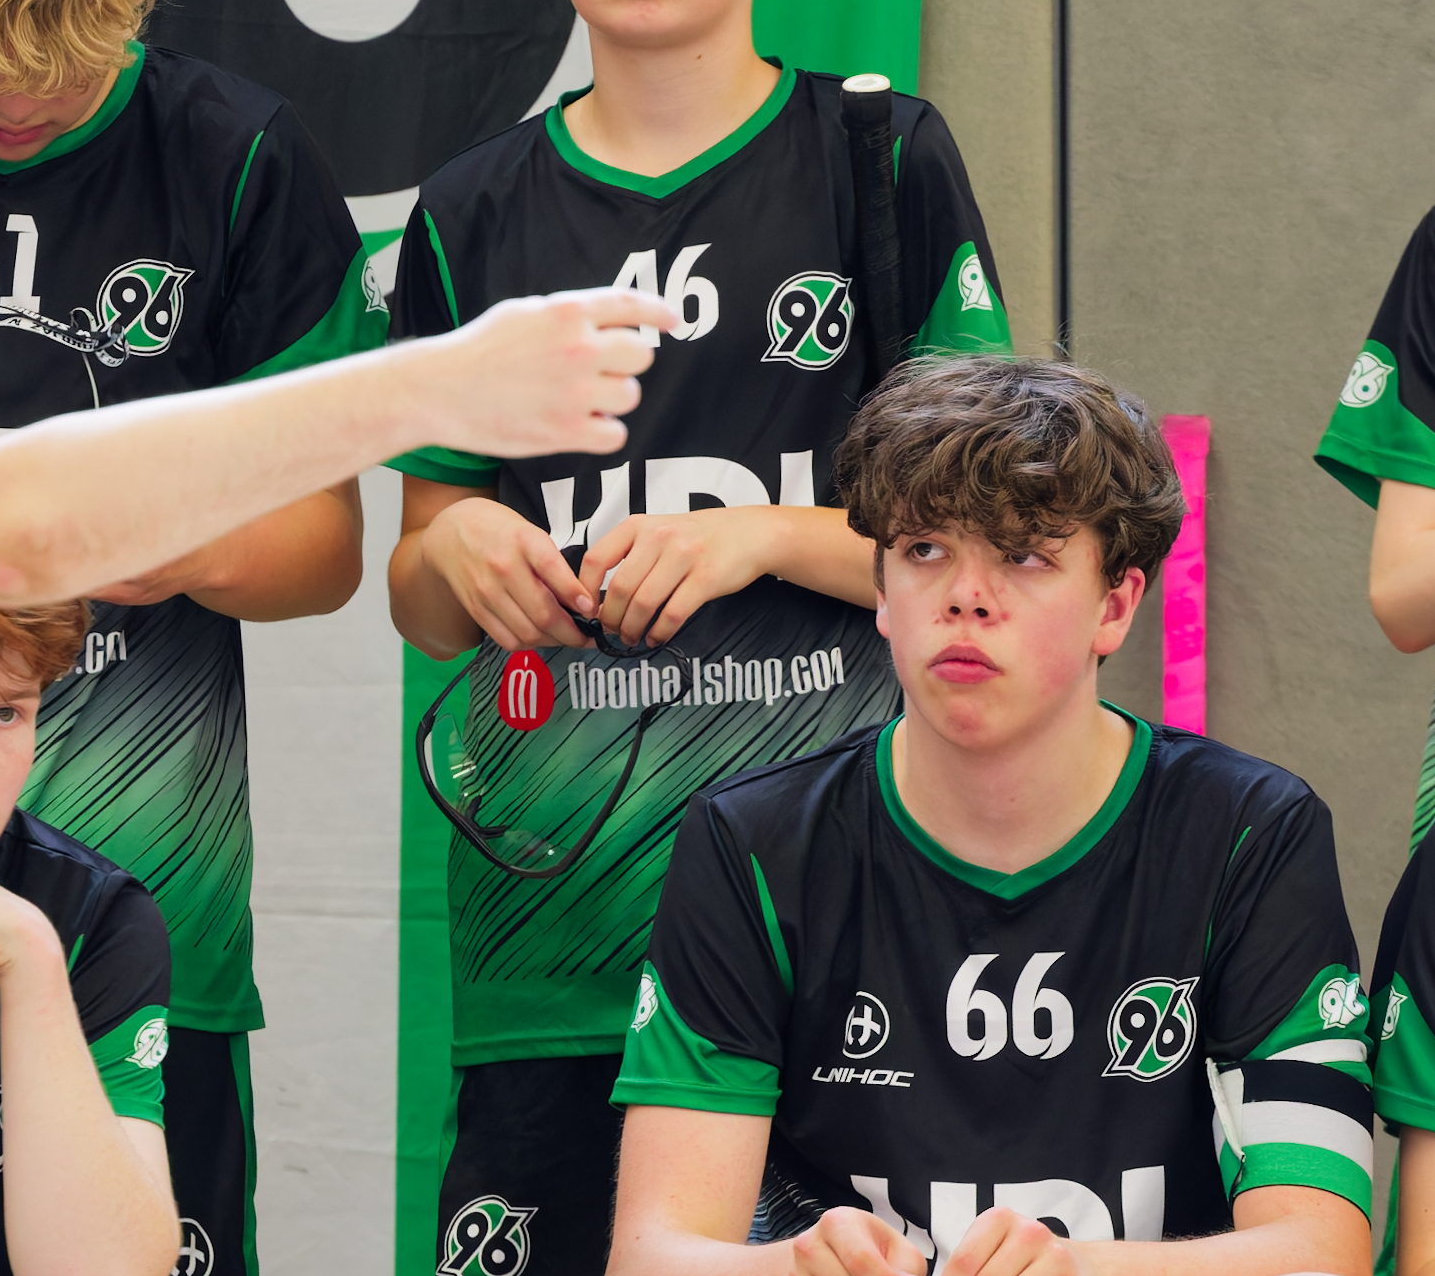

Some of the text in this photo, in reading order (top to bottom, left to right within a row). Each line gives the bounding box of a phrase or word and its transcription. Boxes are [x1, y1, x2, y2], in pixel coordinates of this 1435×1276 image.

[611, 242, 719, 347] 46
[770, 279, 850, 362] 96
[946, 951, 1074, 1061] 66
[1109, 983, 1194, 1076] 96
